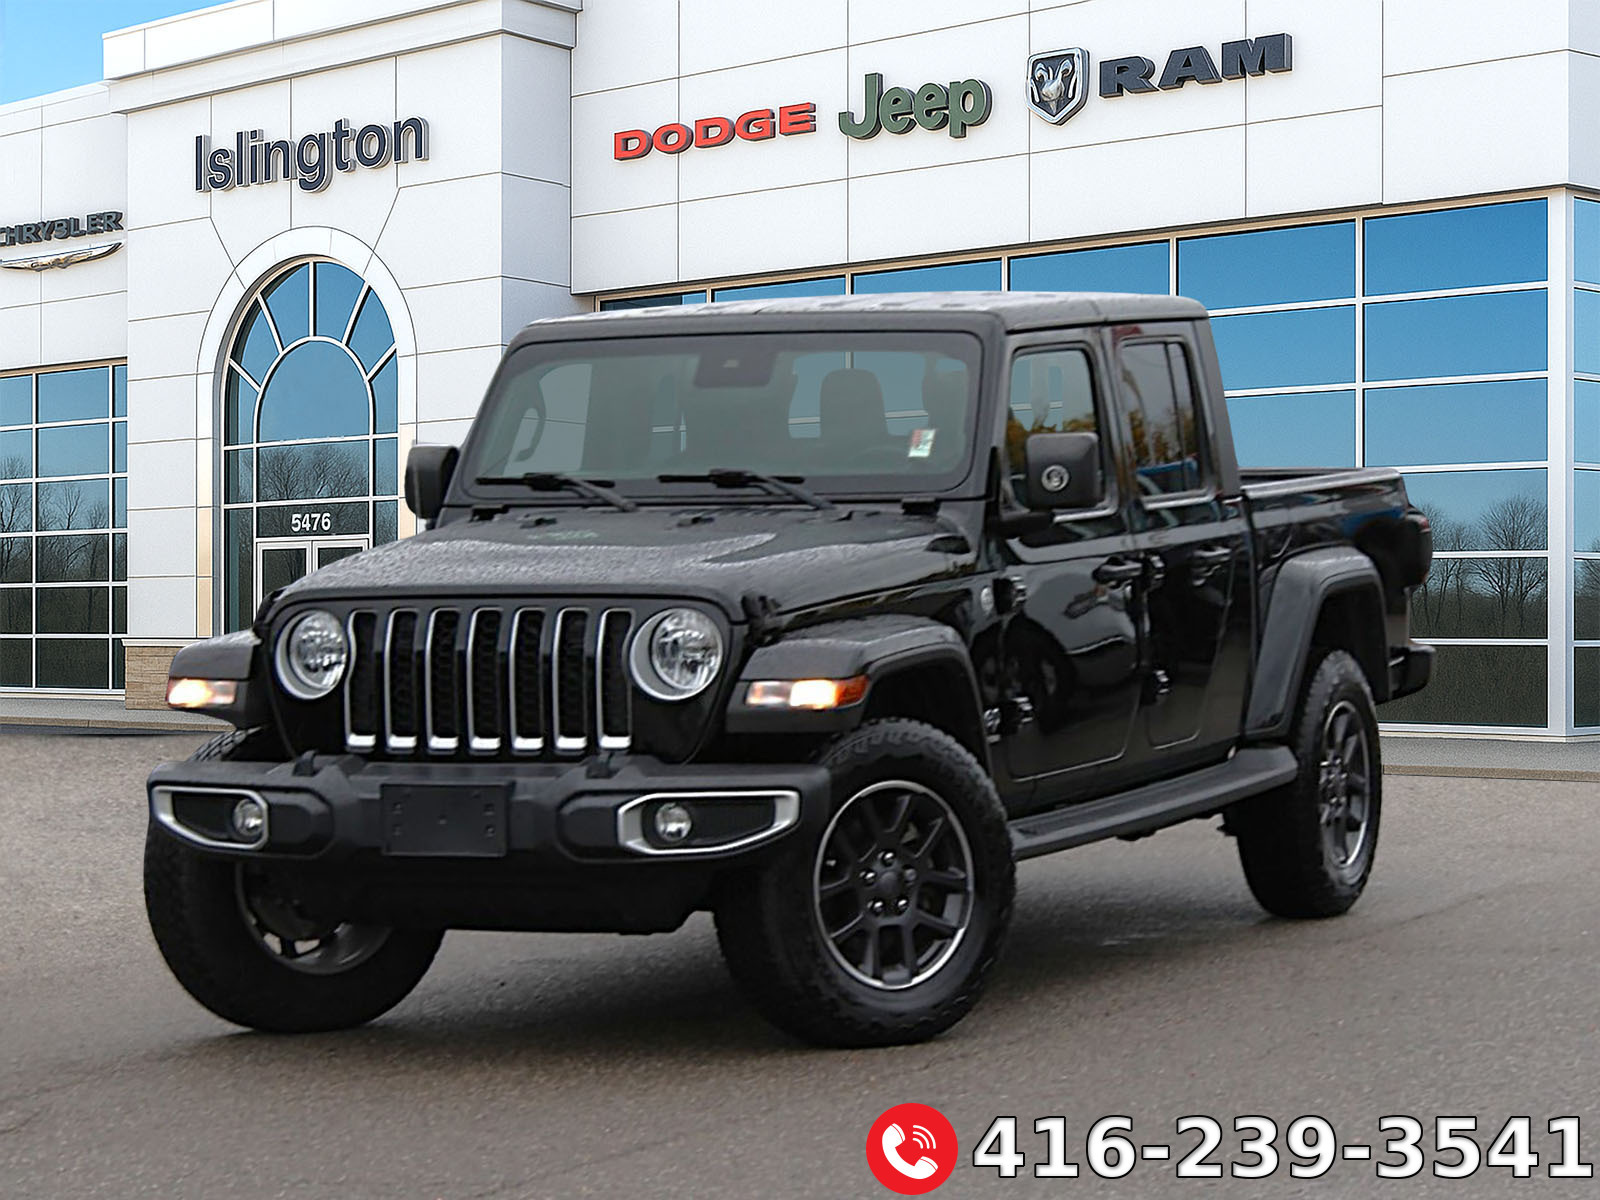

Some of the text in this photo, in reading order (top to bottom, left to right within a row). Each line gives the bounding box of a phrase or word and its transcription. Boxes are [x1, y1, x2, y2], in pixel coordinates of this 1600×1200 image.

[614, 33, 1293, 161] DODGE Jeep RAM
[195, 116, 429, 192] Islington
[291, 512, 331, 532] 5476
